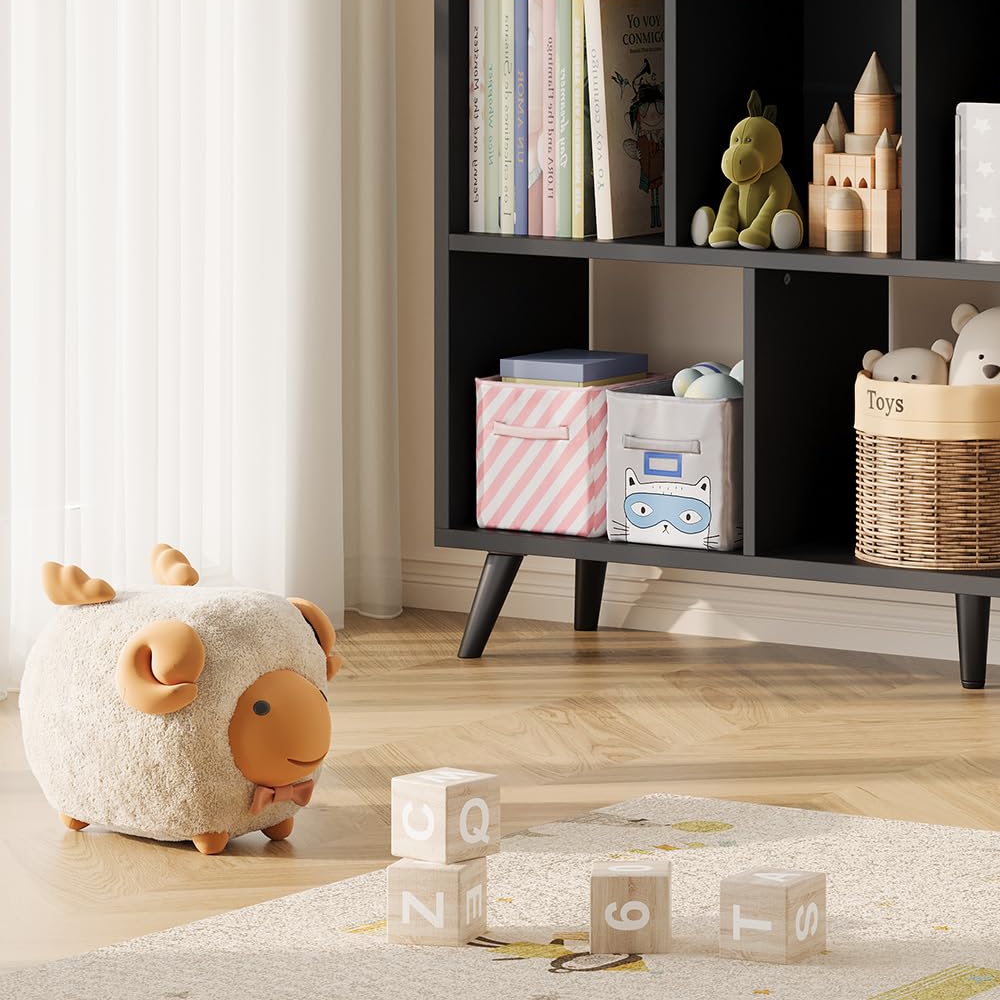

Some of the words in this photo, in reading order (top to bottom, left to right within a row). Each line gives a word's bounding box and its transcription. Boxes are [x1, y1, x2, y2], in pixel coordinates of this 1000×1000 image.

[591, 49, 600, 123] conmigo
[867, 390, 904, 416] Toys
[459, 797, 490, 844] Q
